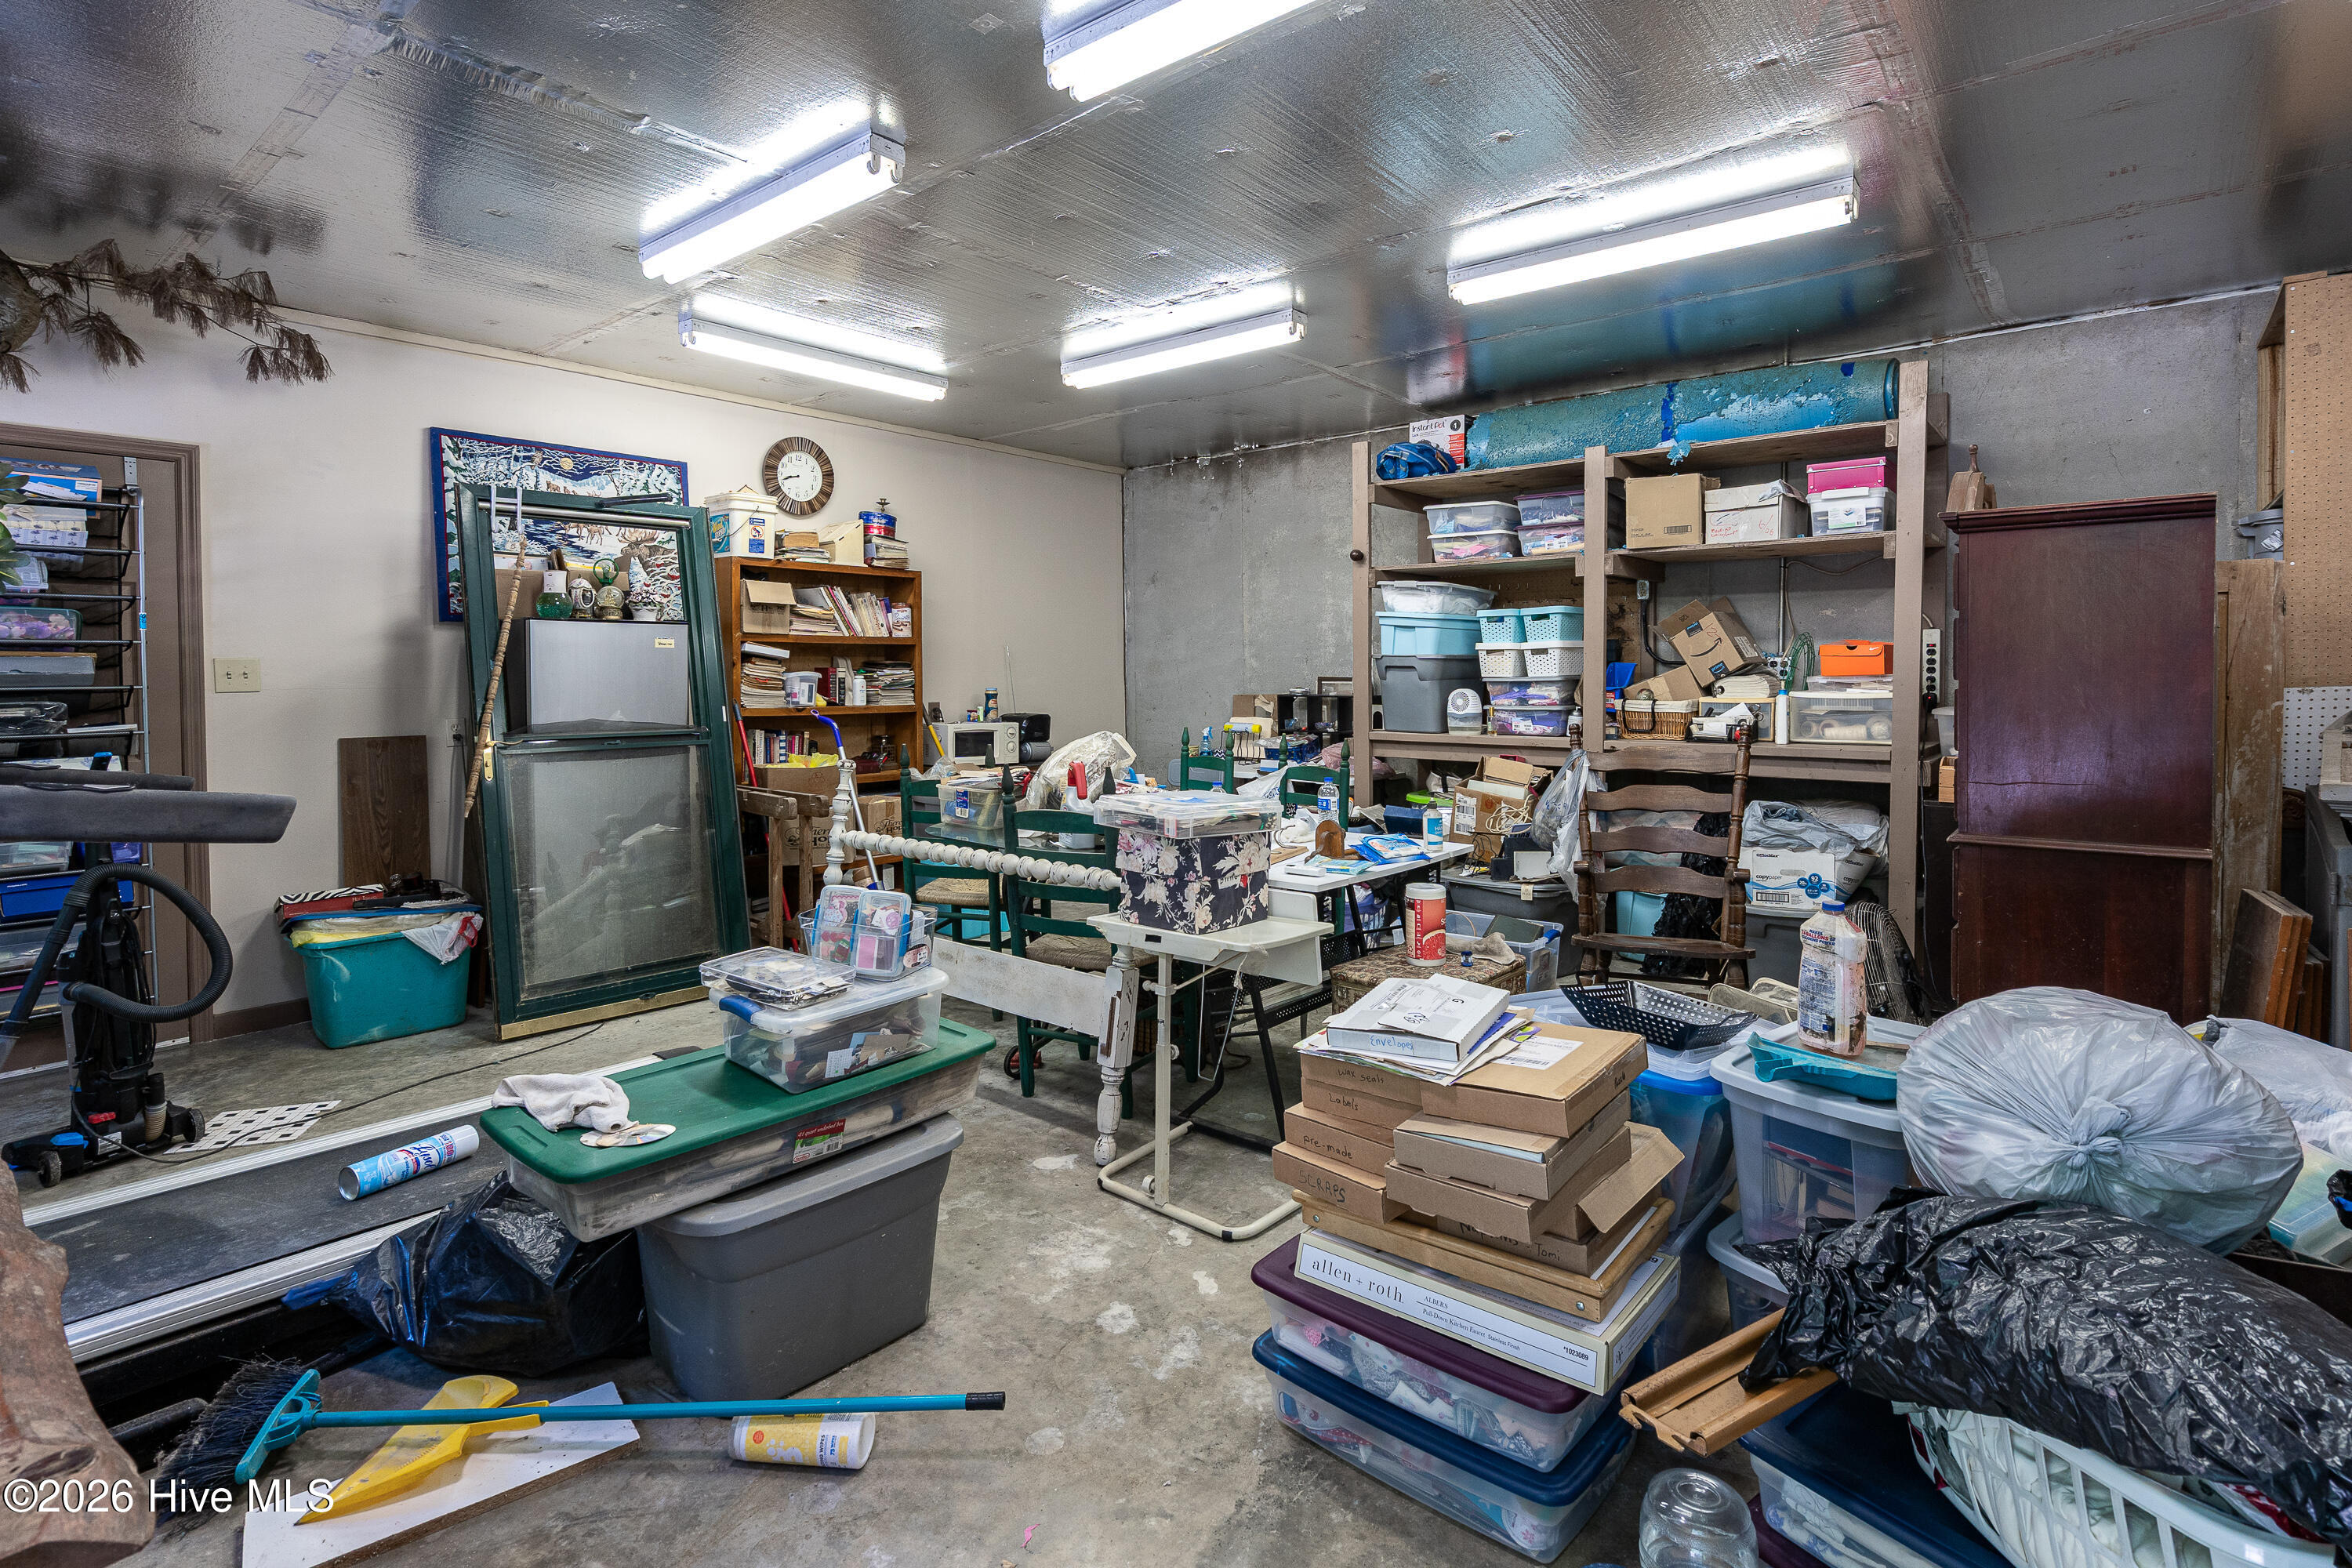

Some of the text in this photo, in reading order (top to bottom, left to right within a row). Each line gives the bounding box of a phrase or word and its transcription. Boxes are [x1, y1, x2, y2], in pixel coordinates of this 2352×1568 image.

[1802, 935, 1819, 943] CLEANING
[1806, 931, 1829, 942] GALLONS
[1370, 1034, 1414, 1051] Envelopes
[1329, 1093, 1358, 1111] Labels
[1303, 1135, 1353, 1159] pre-made
[410, 1144, 437, 1171] Lysol
[1298, 1170, 1346, 1203] SCRAPS
[1534, 1242, 1560, 1261] Tomi
[1312, 1259, 1352, 1283] allen
[1368, 1280, 1404, 1304] roth
[1424, 1296, 1449, 1309] ALBERS
[1422, 1308, 1520, 1351] Pull-Down Kitchen Faucet Stainless Finish
